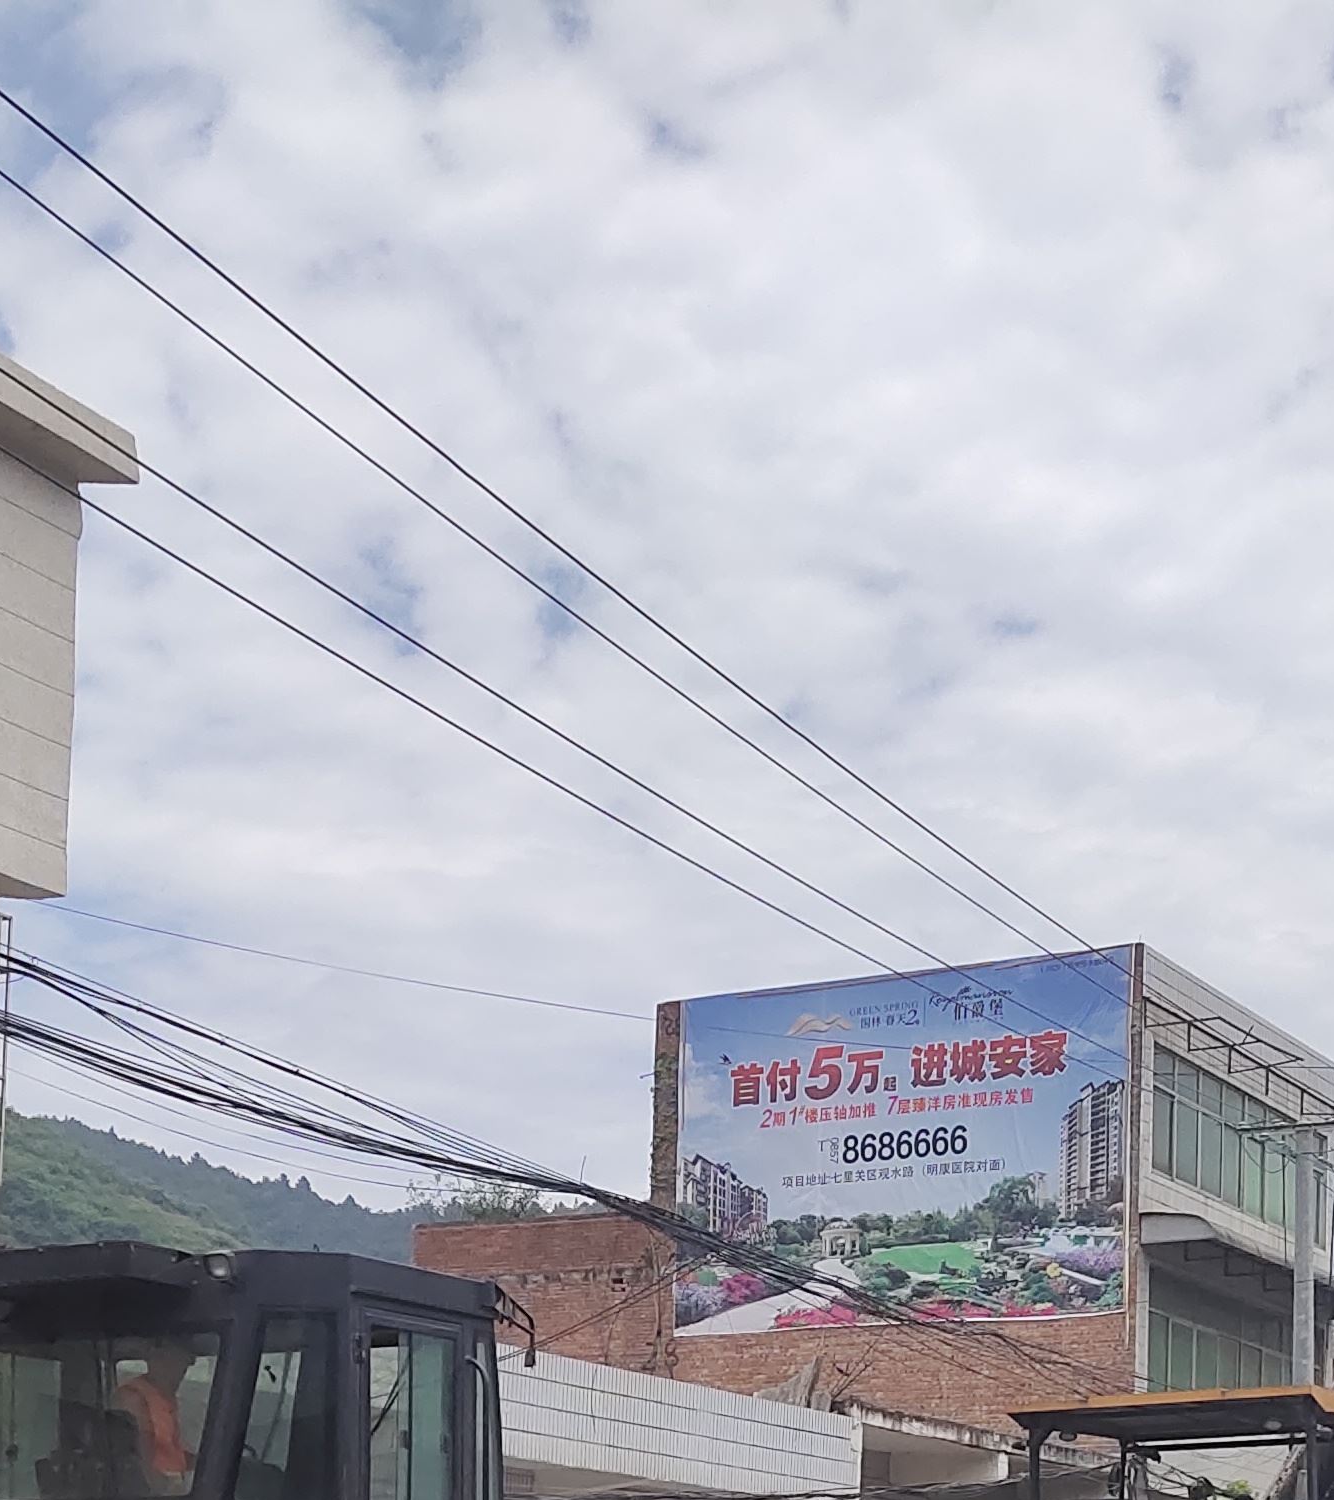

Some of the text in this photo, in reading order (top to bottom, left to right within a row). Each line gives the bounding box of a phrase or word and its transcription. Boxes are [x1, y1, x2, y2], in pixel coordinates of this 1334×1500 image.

[730, 1031, 1067, 1107] 首付5万起 进城安家
[842, 1125, 968, 1164] 8686666
